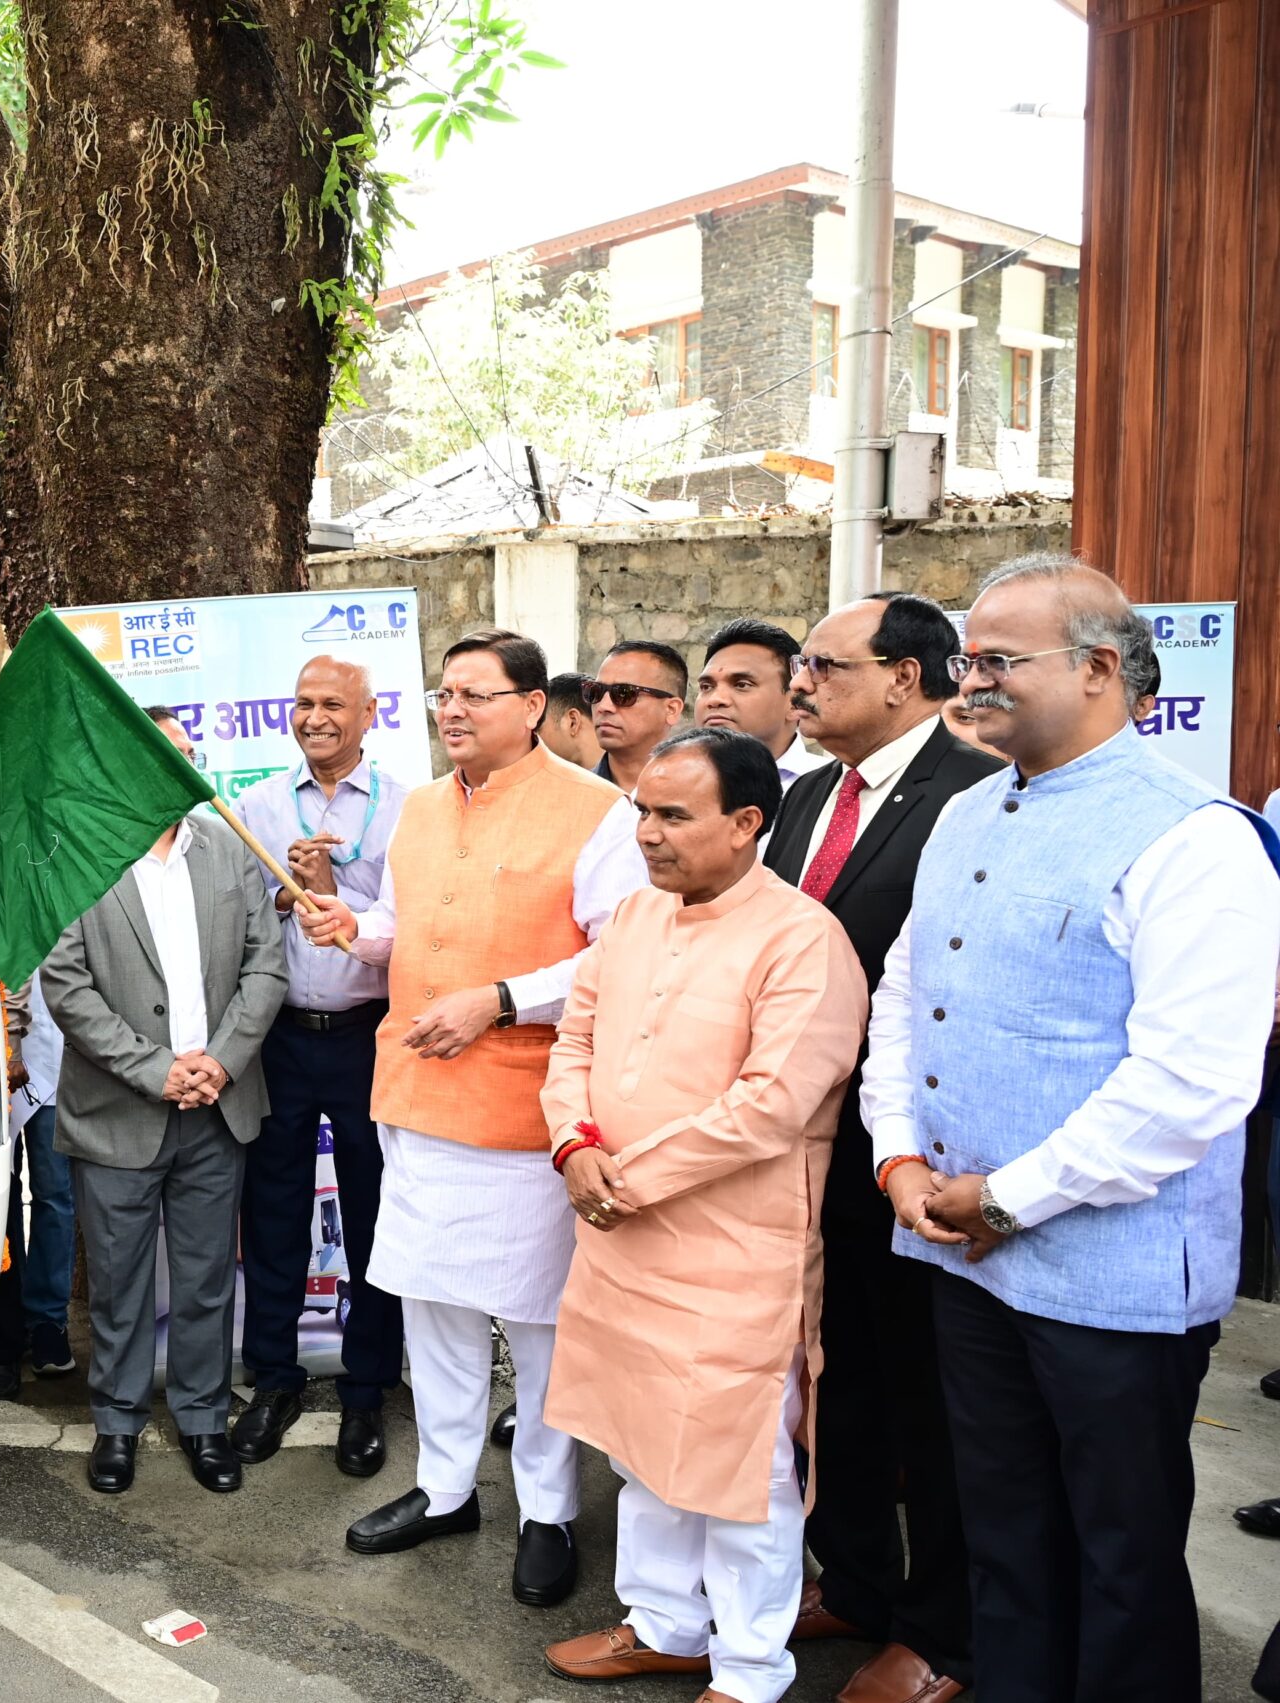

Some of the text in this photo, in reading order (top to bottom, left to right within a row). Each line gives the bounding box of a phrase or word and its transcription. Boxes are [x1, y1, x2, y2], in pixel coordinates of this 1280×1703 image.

[346, 602, 407, 631] CC
[350, 629, 407, 641] ACADEMY
[1153, 613, 1222, 640] CSC
[130, 634, 195, 660] REC
[1155, 639, 1219, 649] ACADEMY
[154, 665, 200, 676] possibilities
